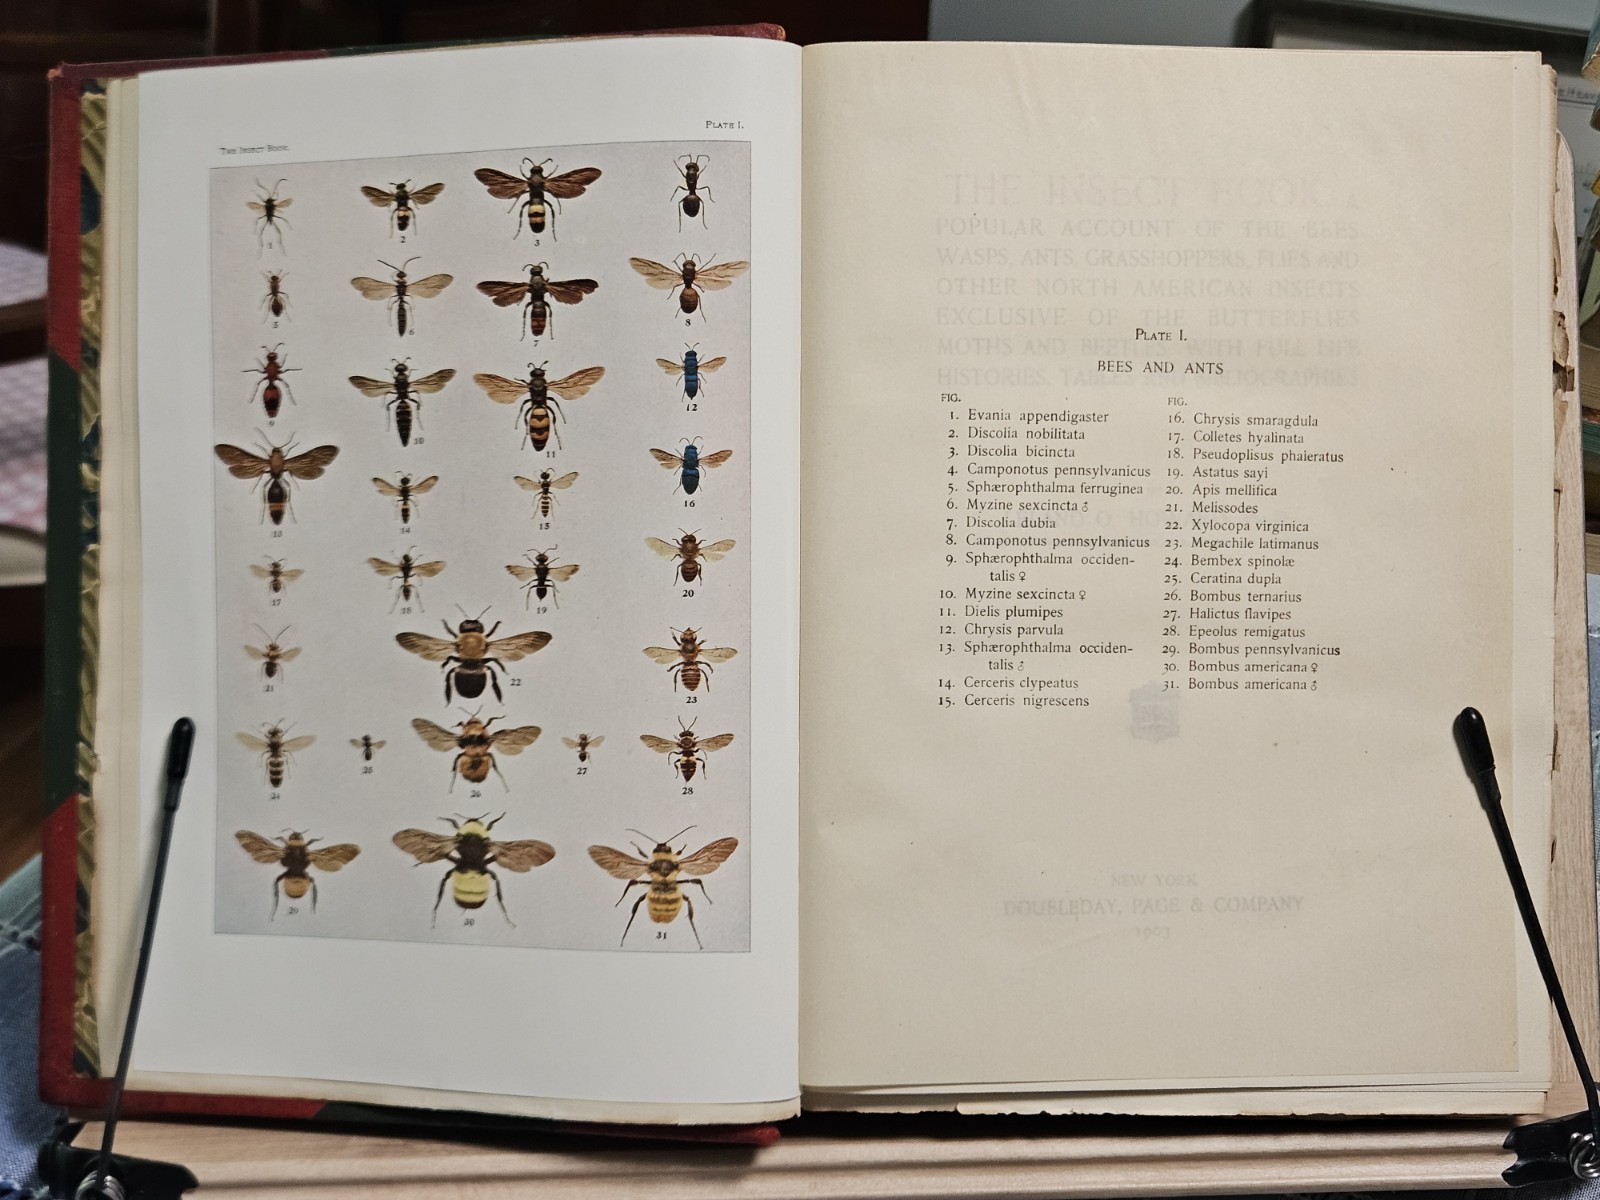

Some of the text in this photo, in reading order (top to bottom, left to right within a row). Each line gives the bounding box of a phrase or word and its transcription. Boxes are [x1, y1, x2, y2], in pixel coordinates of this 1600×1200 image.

[400, 236, 406, 244] 2
[534, 239, 540, 247] 3
[685, 318, 691, 327] 8
[1097, 360, 1223, 375] BEES AND ANTS
[941, 393, 961, 402] FIG.
[1168, 397, 1187, 406] FIG.
[686, 403, 697, 411] 12
[950, 408, 1109, 425] 1. Evania appendigaster
[1169, 411, 1318, 429] 16. Chrysis smaragdula
[948, 426, 1085, 440] 2. Discolia nobilitata
[1169, 430, 1304, 447] 17. Colletes hyalinata
[948, 444, 1075, 459] 3. Discolia bicincta
[1168, 447, 1184, 459] 18.
[1193, 448, 1274, 464] Pseudoplisus
[947, 462, 1151, 479] 4. Camponotus pennsylvanicus
[1168, 466, 1268, 482] 19. Astatus sayi
[948, 483, 958, 495] 5.
[1080, 482, 1143, 497] ferruginea
[1165, 483, 1277, 499] 20. Apis mellifica
[684, 500, 695, 508] 16
[946, 498, 958, 509] 6.
[1019, 499, 1078, 511] sexcincta
[1165, 501, 1258, 514] 21. Melissodes
[539, 522, 550, 530] 15
[946, 518, 957, 531] 7.
[966, 516, 1016, 528] Discolia
[1021, 517, 1056, 528] dubia
[1165, 521, 1182, 530] 22.
[1192, 518, 1250, 534] Xylocopa
[1255, 520, 1309, 535] virginica
[945, 533, 1150, 551] 8. Camponotus pennsylvanicus
[1165, 536, 1319, 551] 23. Megachile latimanus
[945, 554, 957, 566] 9.
[1081, 553, 1135, 565] occiden-
[1164, 557, 1182, 568] 24.
[1191, 554, 1242, 566] Bembex
[990, 569, 1015, 582] talis
[1164, 575, 1182, 586] 25.
[1190, 572, 1242, 584] Ceratina
[682, 589, 694, 598] 20
[940, 590, 956, 599] 10.
[1016, 588, 1075, 600] sexcincta
[1163, 589, 1302, 603] 26. Bombus ternarius
[537, 606, 548, 614] 19
[940, 605, 1063, 621] 11. Dielis plumipes
[1163, 607, 1291, 623] 27. Halictus flavipes
[940, 622, 1063, 638] 12. Chrysis parvula
[1162, 625, 1305, 640] 28. Epeolus remigatus
[939, 643, 955, 655] 13.
[1079, 642, 1133, 654] occiden-
[1162, 642, 1341, 658] 29. Bombus pennsylvanicus
[988, 658, 1014, 670] talis
[1163, 660, 1307, 674] 30. Bombus americana
[510, 678, 522, 687] 22
[939, 679, 955, 690] 14.
[964, 676, 1015, 688] Cerceris
[1162, 677, 1307, 692] 31. Bombus americana
[686, 696, 697, 704] 23
[939, 693, 1089, 709] 15. Cerceris nigrescens
[577, 767, 588, 775] 27
[682, 787, 694, 795] 28
[656, 931, 667, 940] 31
